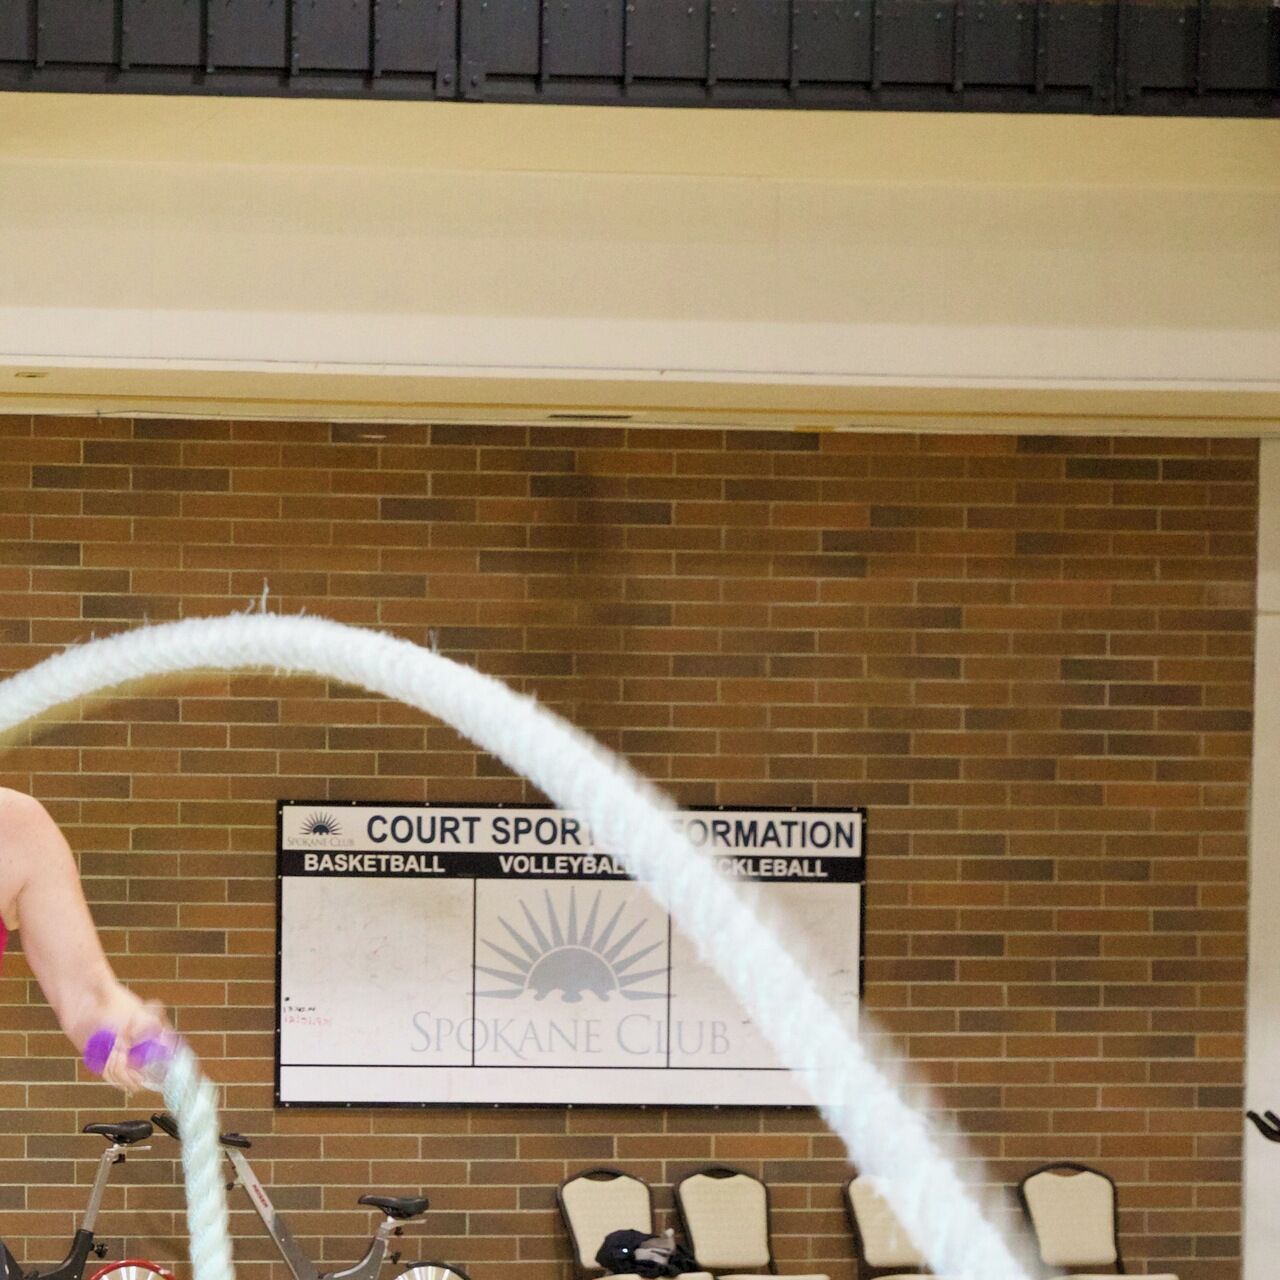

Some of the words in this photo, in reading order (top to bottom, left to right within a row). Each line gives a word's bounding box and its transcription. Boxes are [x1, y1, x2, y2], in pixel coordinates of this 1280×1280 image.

[366, 814, 482, 844] COURT
[491, 816, 595, 847] SPOR
[303, 853, 446, 873] BASKETBALL
[716, 857, 828, 878] CKLEBALL
[411, 1010, 602, 1060] SPOKANE
[616, 1013, 731, 1056] CLUB
